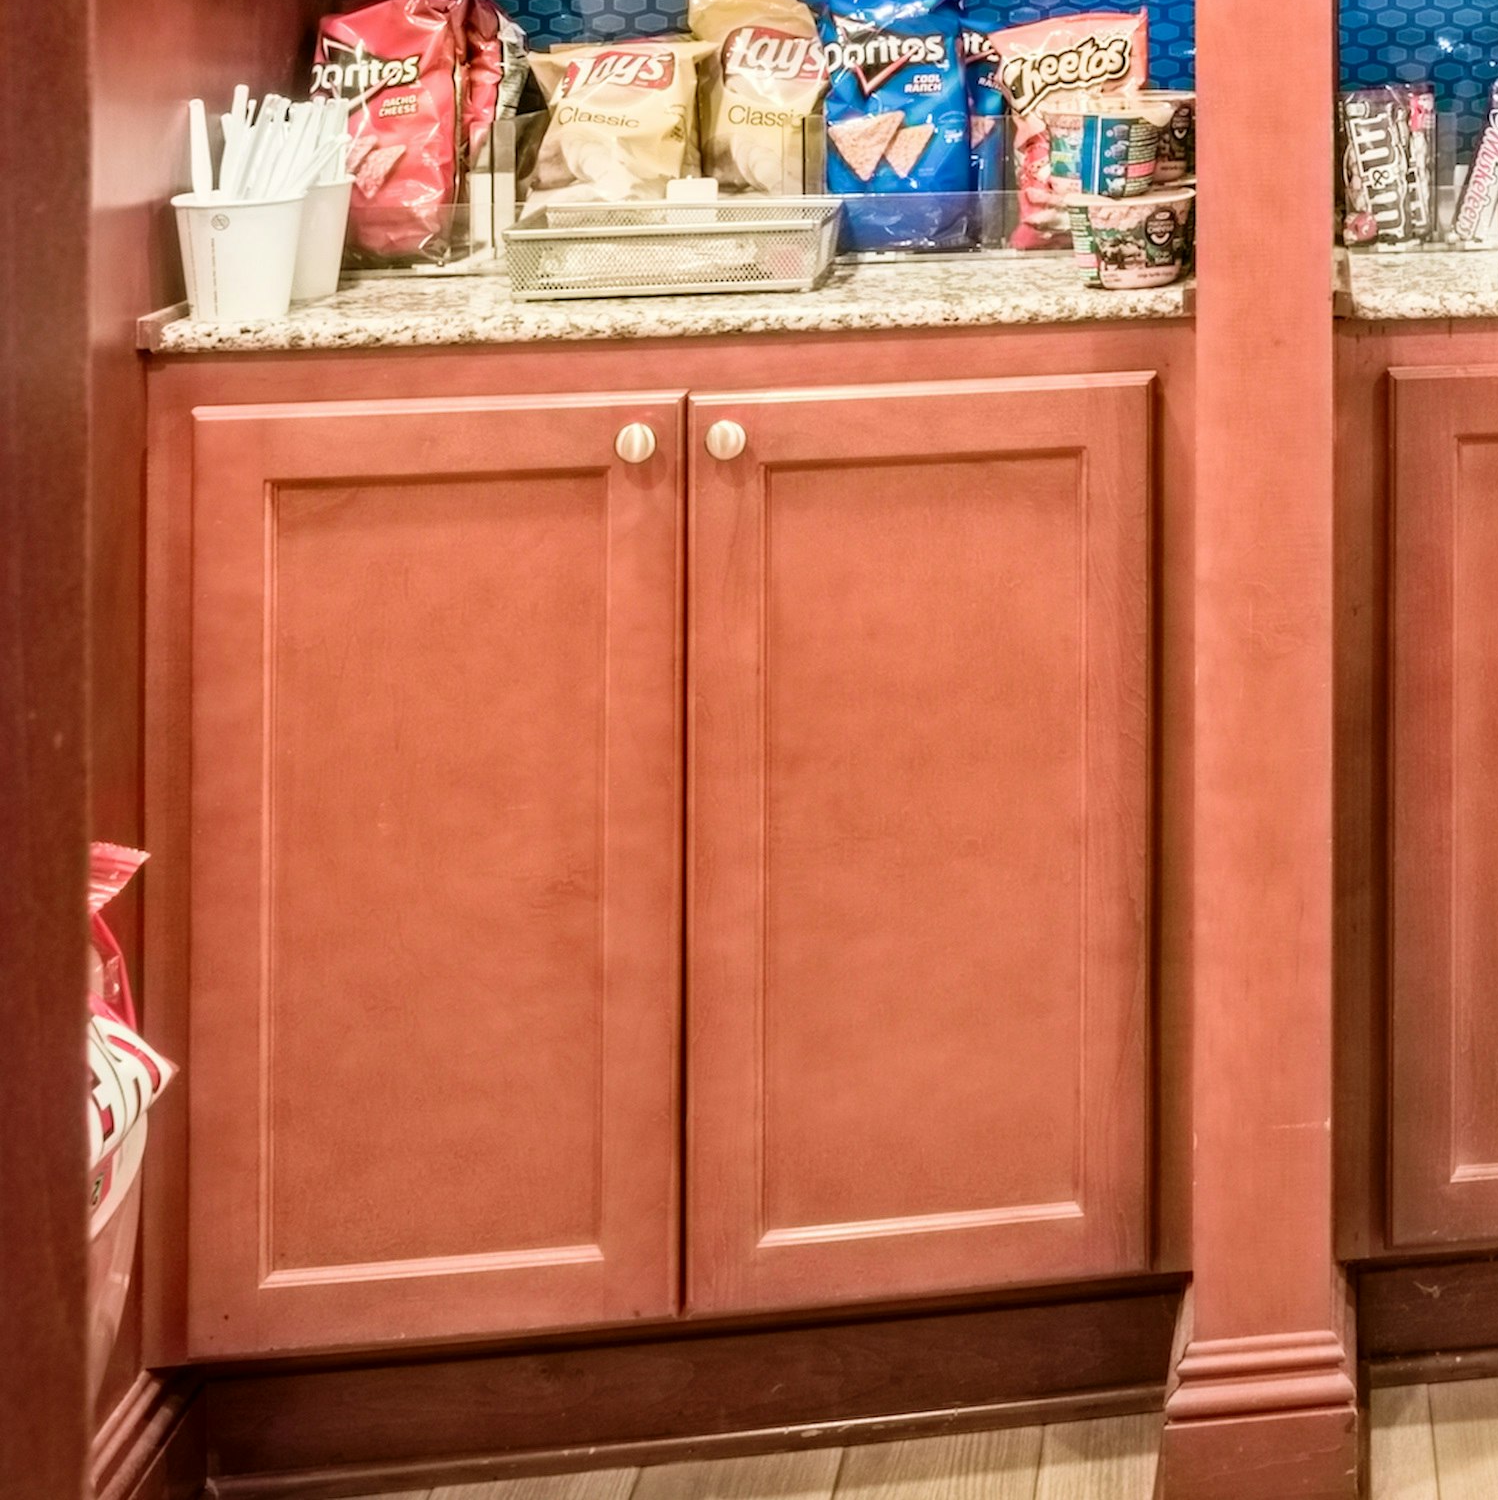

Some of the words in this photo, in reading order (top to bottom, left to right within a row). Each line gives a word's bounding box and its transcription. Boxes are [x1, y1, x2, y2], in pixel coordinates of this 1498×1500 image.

[822, 34, 946, 72] Doritos
[912, 73, 942, 84] COOL
[1002, 36, 1132, 111] Cheetos
[903, 82, 944, 95] RANCH
[382, 94, 418, 108] NACHO
[377, 104, 418, 118] CHEESE
[557, 104, 641, 130] Classic
